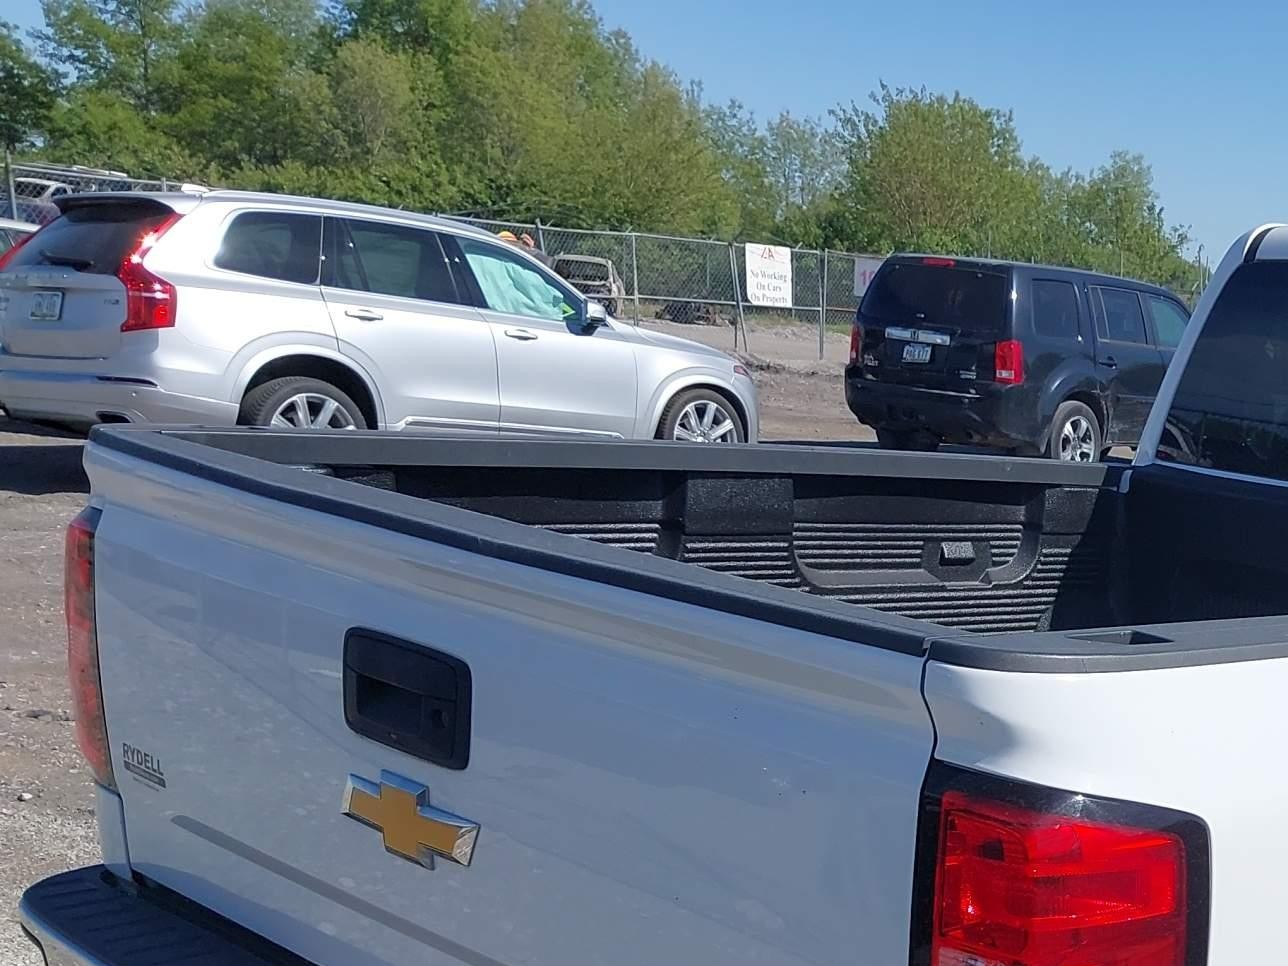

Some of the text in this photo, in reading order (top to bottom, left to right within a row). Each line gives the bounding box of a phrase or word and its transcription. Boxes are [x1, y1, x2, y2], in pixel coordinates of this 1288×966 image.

[760, 270, 787, 283] Working
[756, 282, 782, 292] On Cars
[750, 292, 788, 305] On Property
[122, 742, 164, 776] RYDELL
